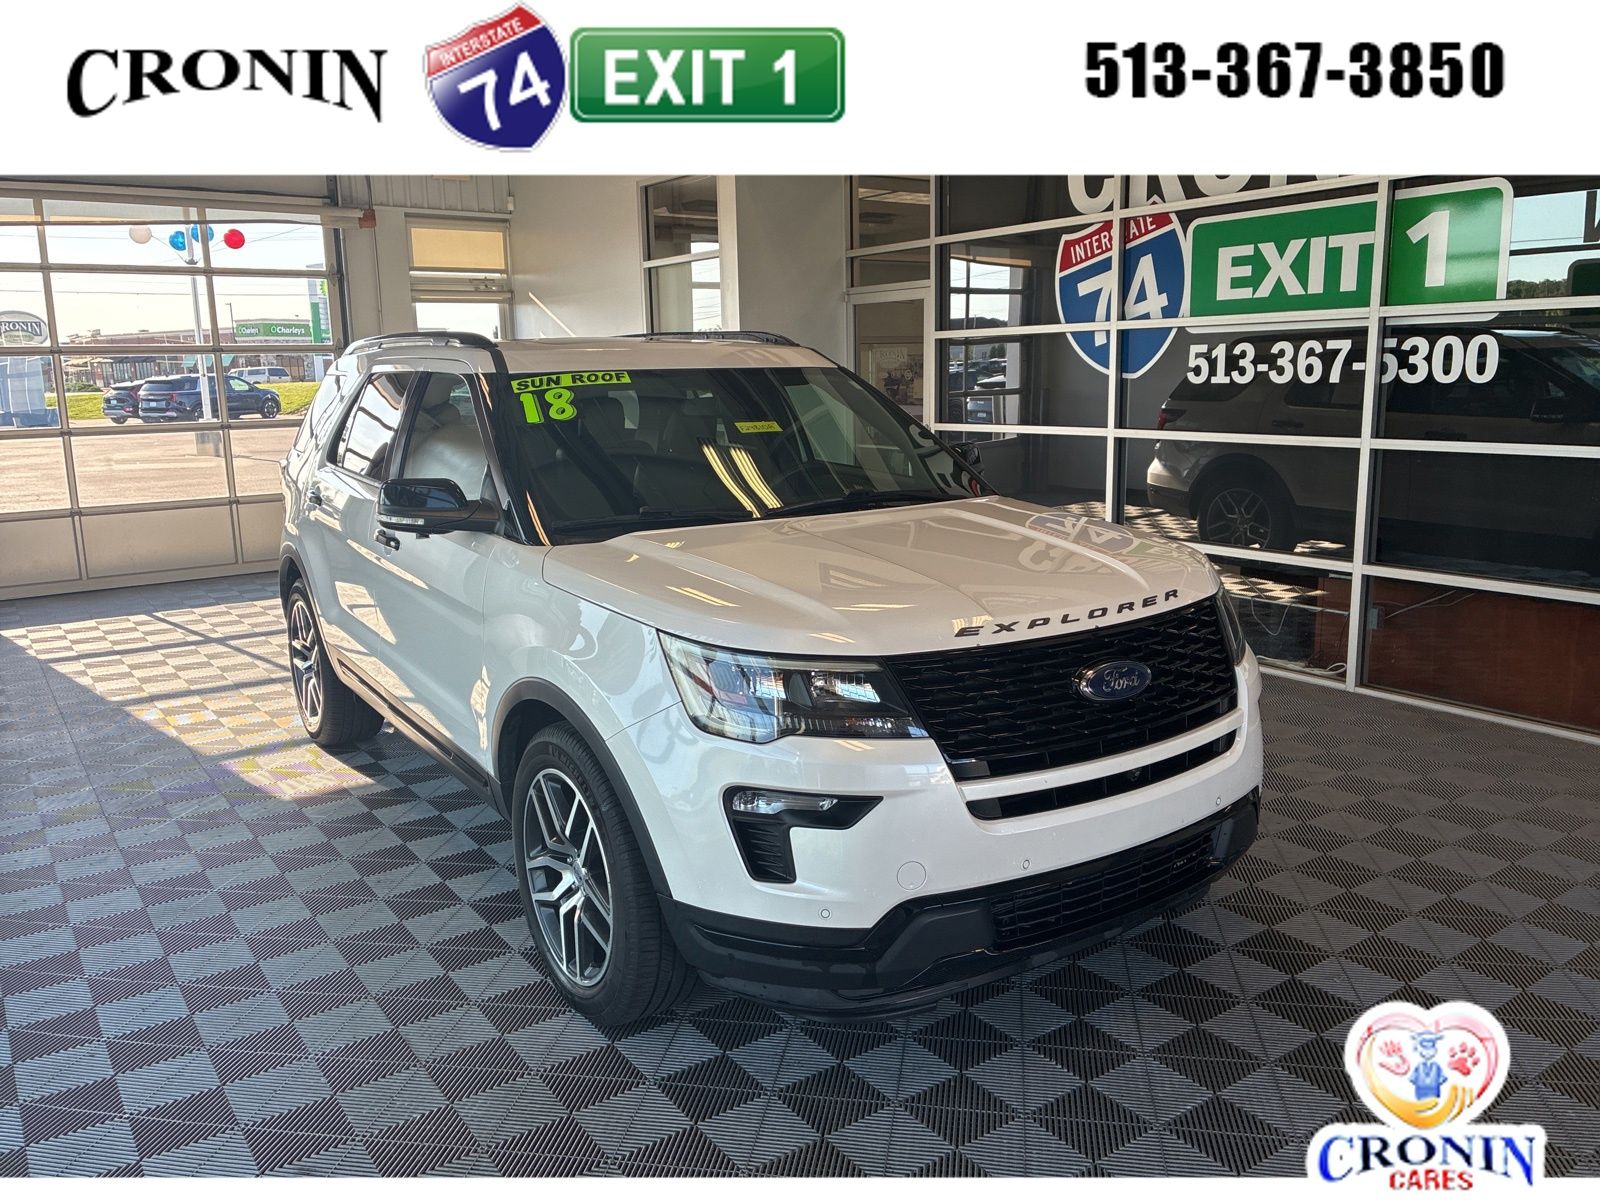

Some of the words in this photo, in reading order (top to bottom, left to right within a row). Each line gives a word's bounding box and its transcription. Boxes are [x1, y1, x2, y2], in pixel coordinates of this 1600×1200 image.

[1070, 215, 1157, 264] INTERATE
[1216, 231, 1376, 301] EXIT
[1405, 210, 1450, 288] 1
[1077, 253, 1169, 346] 74
[0, 322, 41, 337] RONIN
[516, 375, 560, 391] SUN
[571, 372, 626, 384] ROOF
[1186, 334, 1499, 384] 513-367-5300
[520, 388, 577, 424] 18
[954, 588, 1178, 638] EXPLORER
[1103, 667, 1140, 692] Ford
